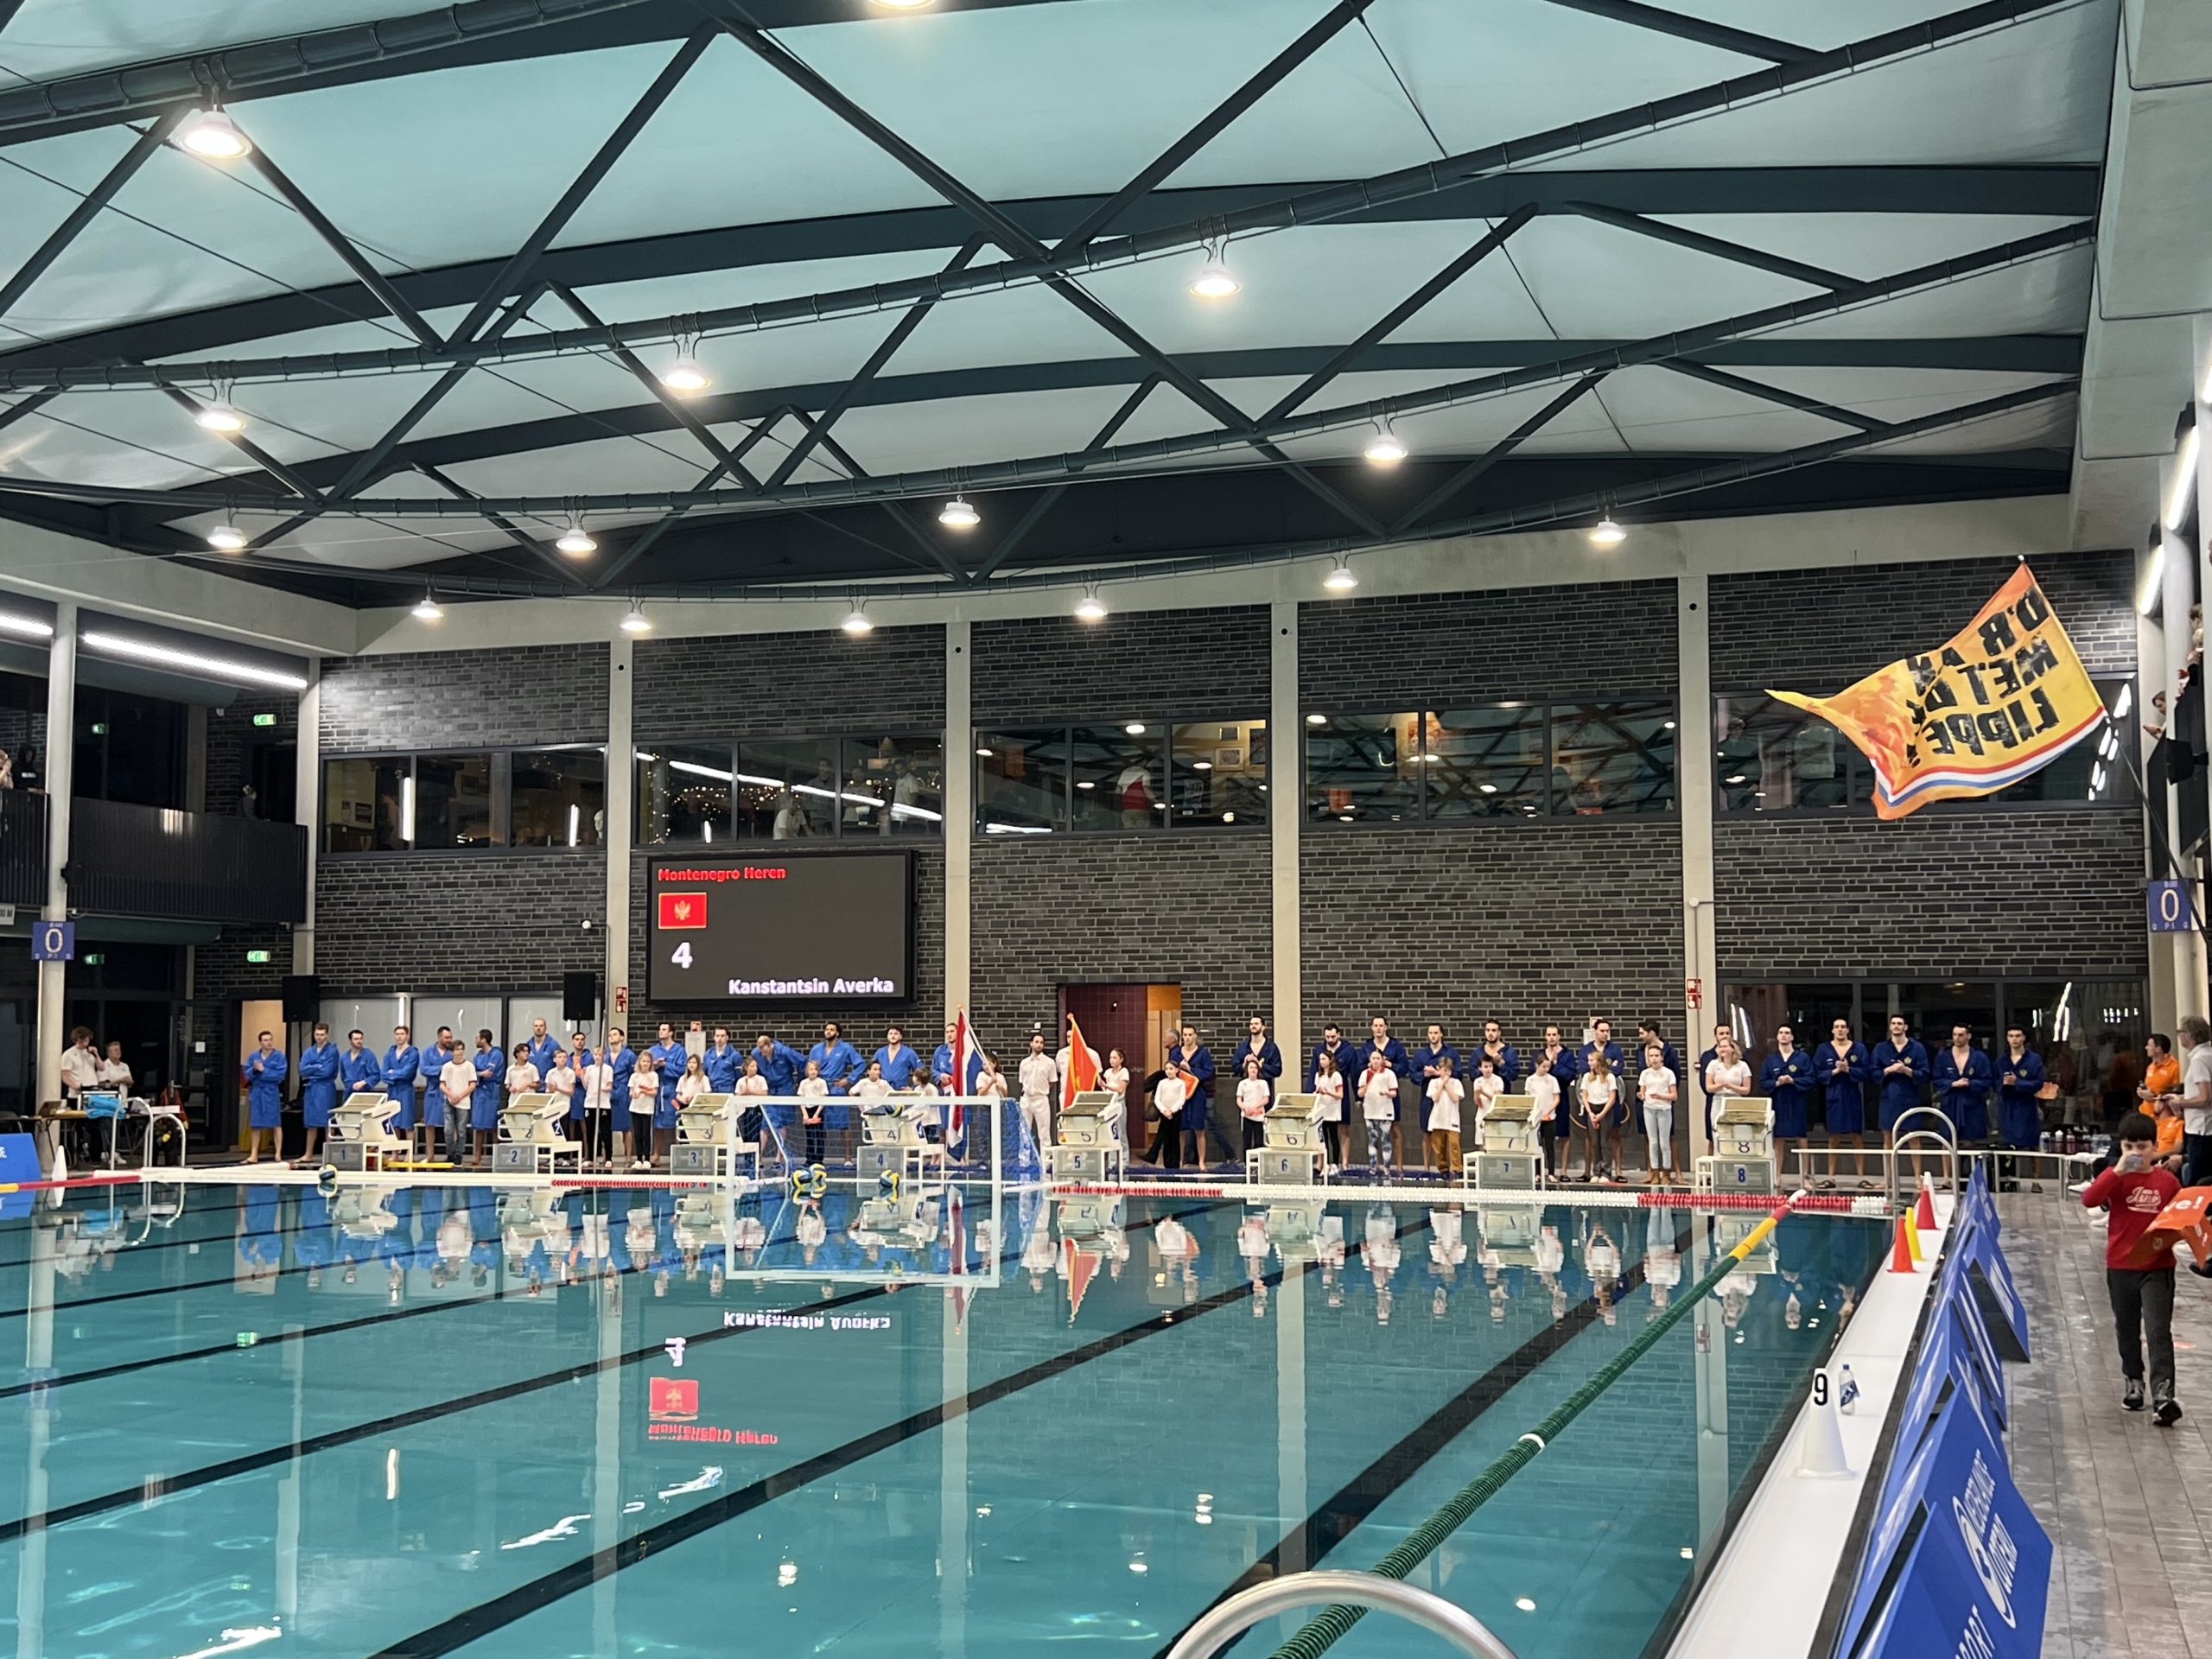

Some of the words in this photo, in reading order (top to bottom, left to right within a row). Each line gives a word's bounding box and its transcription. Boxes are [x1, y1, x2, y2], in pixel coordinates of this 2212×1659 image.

[658, 868, 741, 882] Montenegro
[744, 867, 786, 880] Heren
[2161, 888, 2179, 922] 0
[45, 928, 63, 953] 0
[671, 942, 693, 969] 4
[728, 978, 829, 995] Kanstantsin
[833, 977, 894, 994] Averka
[555, 1123, 561, 1134] 2
[887, 1130, 896, 1140] 4
[1081, 1132, 1091, 1141] 5
[1287, 1134, 1297, 1145] 6
[341, 1147, 346, 1160] 1
[1738, 1141, 1750, 1153] 8
[511, 1150, 518, 1163] 2
[691, 1152, 696, 1164] 3
[878, 1154, 883, 1166] 4
[1074, 1155, 1081, 1168] 5
[1281, 1159, 1288, 1172] 6
[1503, 1163, 1509, 1173] 7
[1738, 1167, 1745, 1182] 8
[1814, 1373, 1827, 1406] 9
